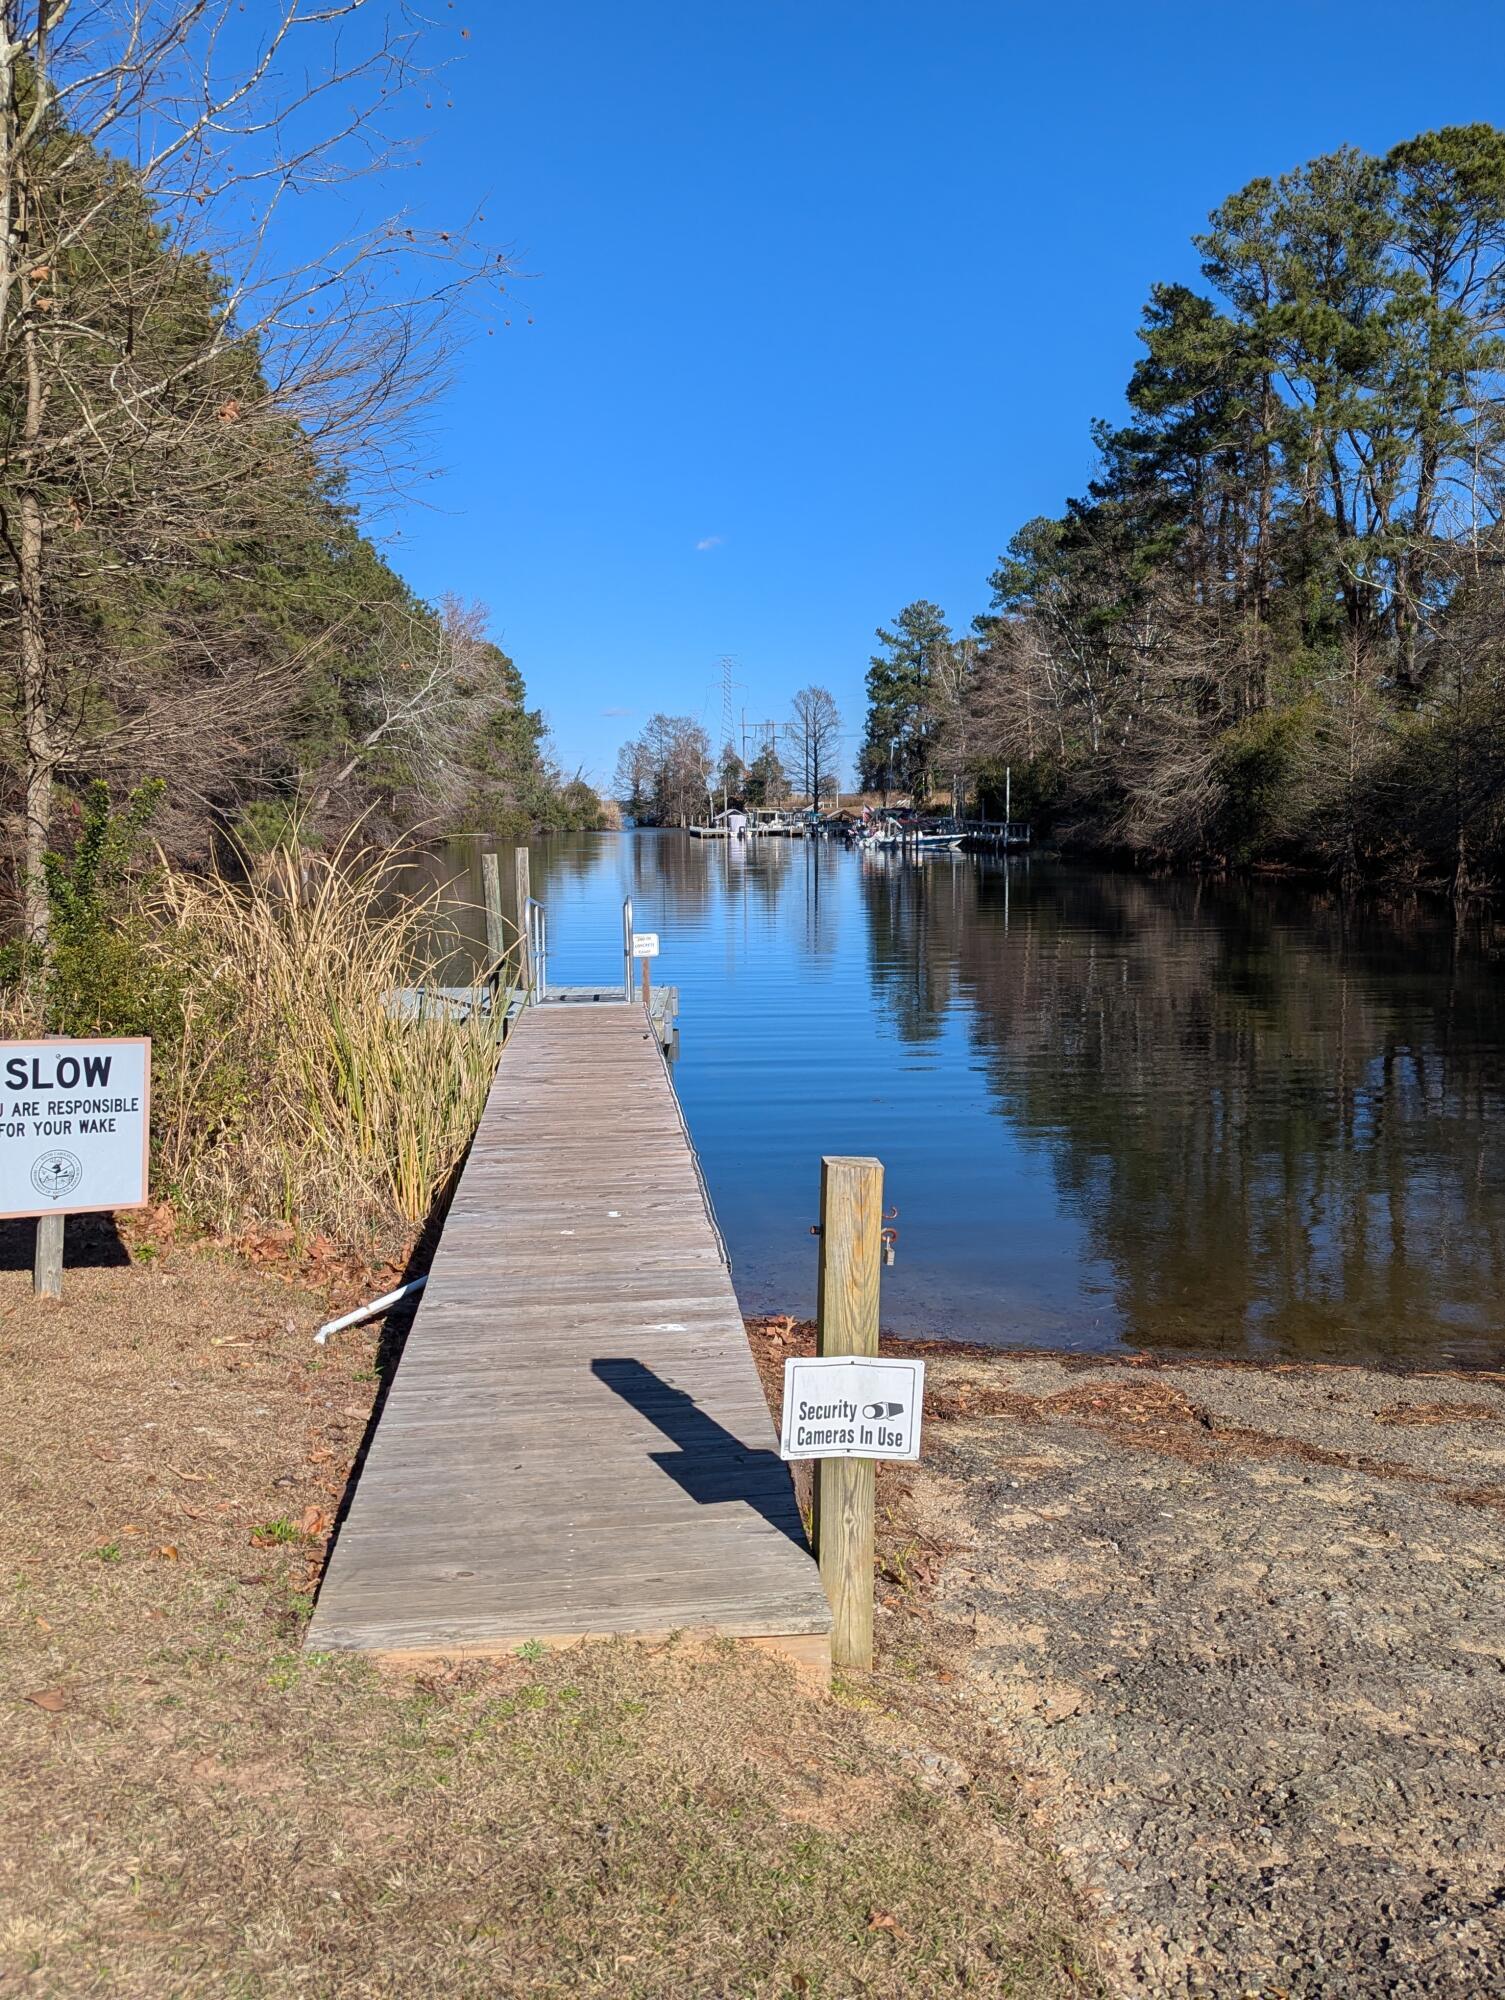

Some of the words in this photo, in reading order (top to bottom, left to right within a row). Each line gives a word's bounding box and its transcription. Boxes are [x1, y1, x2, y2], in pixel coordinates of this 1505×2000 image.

[5, 1056, 112, 1090] SLOW
[11, 1102, 40, 1117] ARE
[48, 1098, 139, 1116] RESPONSIBLE
[33, 1120, 72, 1136] YOUR
[79, 1118, 116, 1134] WAKE
[799, 1399, 857, 1422] Security
[797, 1426, 854, 1446] Cameras
[860, 1425, 873, 1445] In
[878, 1426, 903, 1447] Use
